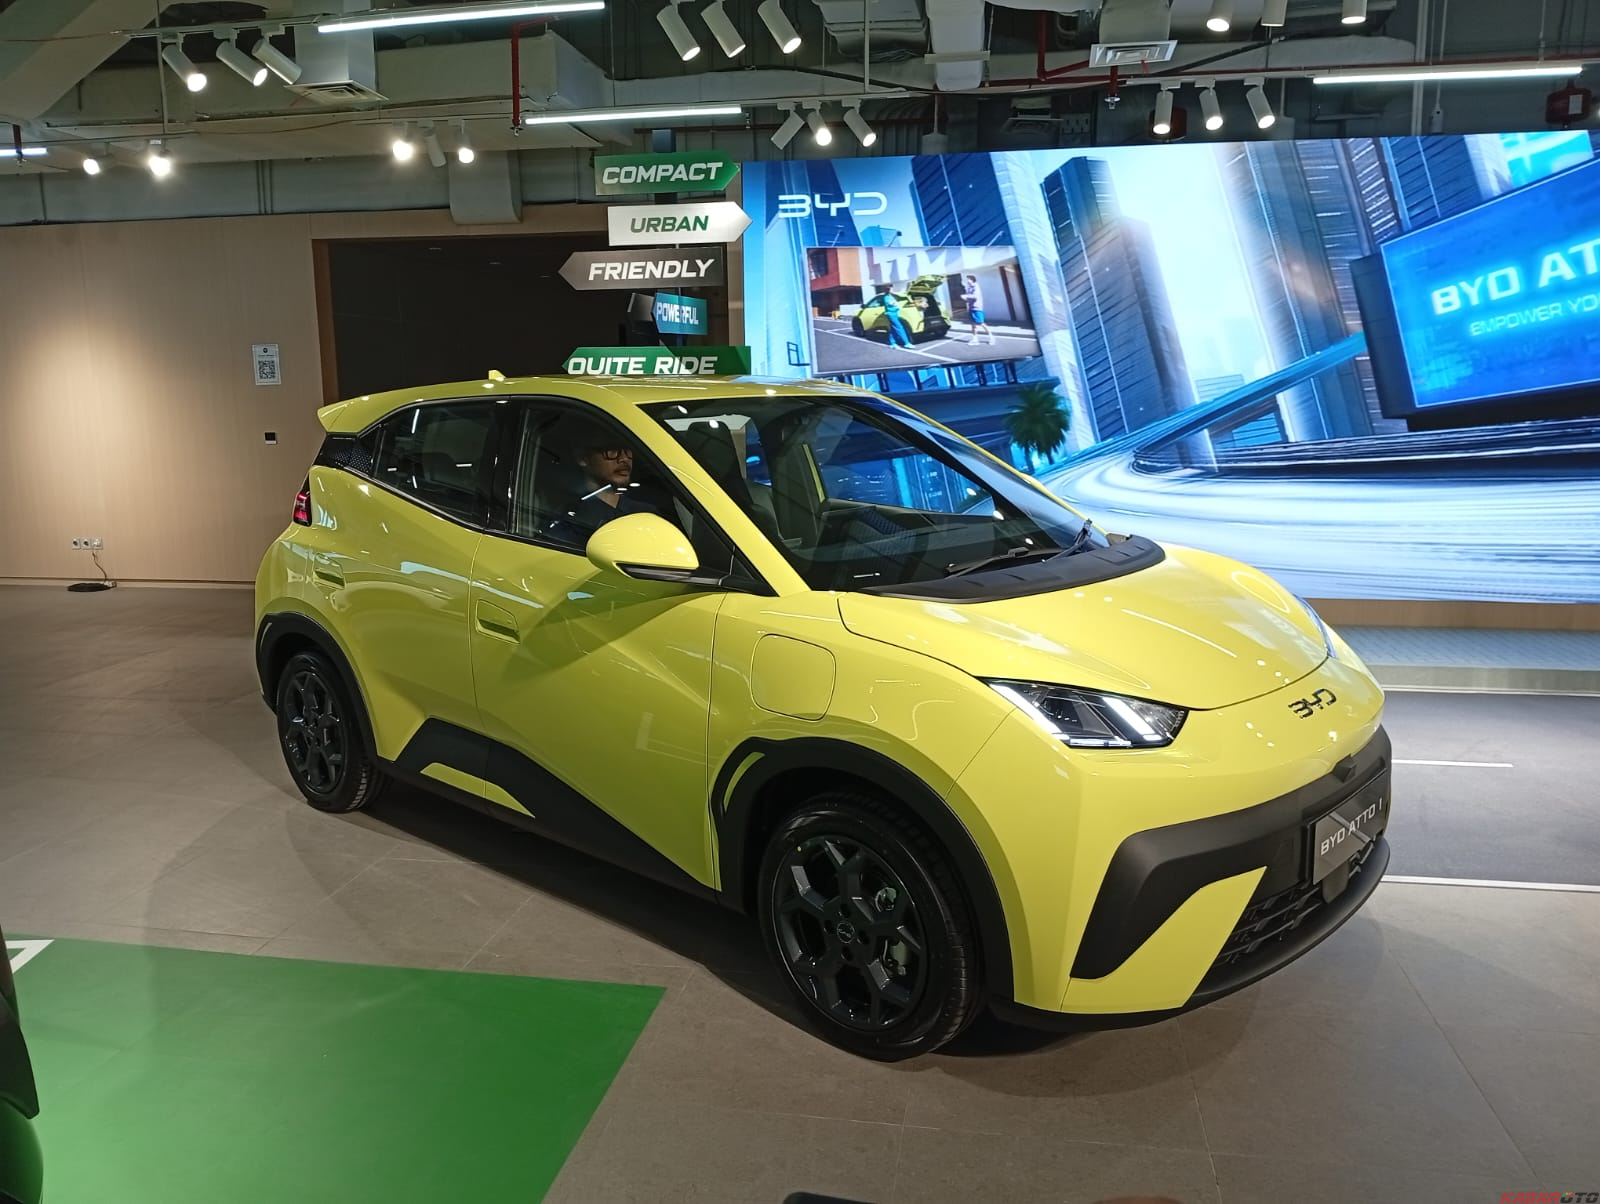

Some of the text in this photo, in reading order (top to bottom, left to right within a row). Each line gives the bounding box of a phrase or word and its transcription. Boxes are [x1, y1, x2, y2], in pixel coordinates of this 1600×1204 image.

[602, 162, 723, 185] COMPACT
[778, 191, 887, 218] BYD
[630, 215, 709, 234] URBAN
[588, 259, 715, 281] FRIENDLY
[1431, 266, 1521, 315] BYD
[656, 301, 699, 325] POWERFUL
[1470, 302, 1563, 336] EMPOWER
[654, 356, 718, 375] RIDE
[1288, 688, 1337, 719] BYD
[1320, 827, 1346, 856] BYD
[1348, 803, 1376, 836] ATTO
